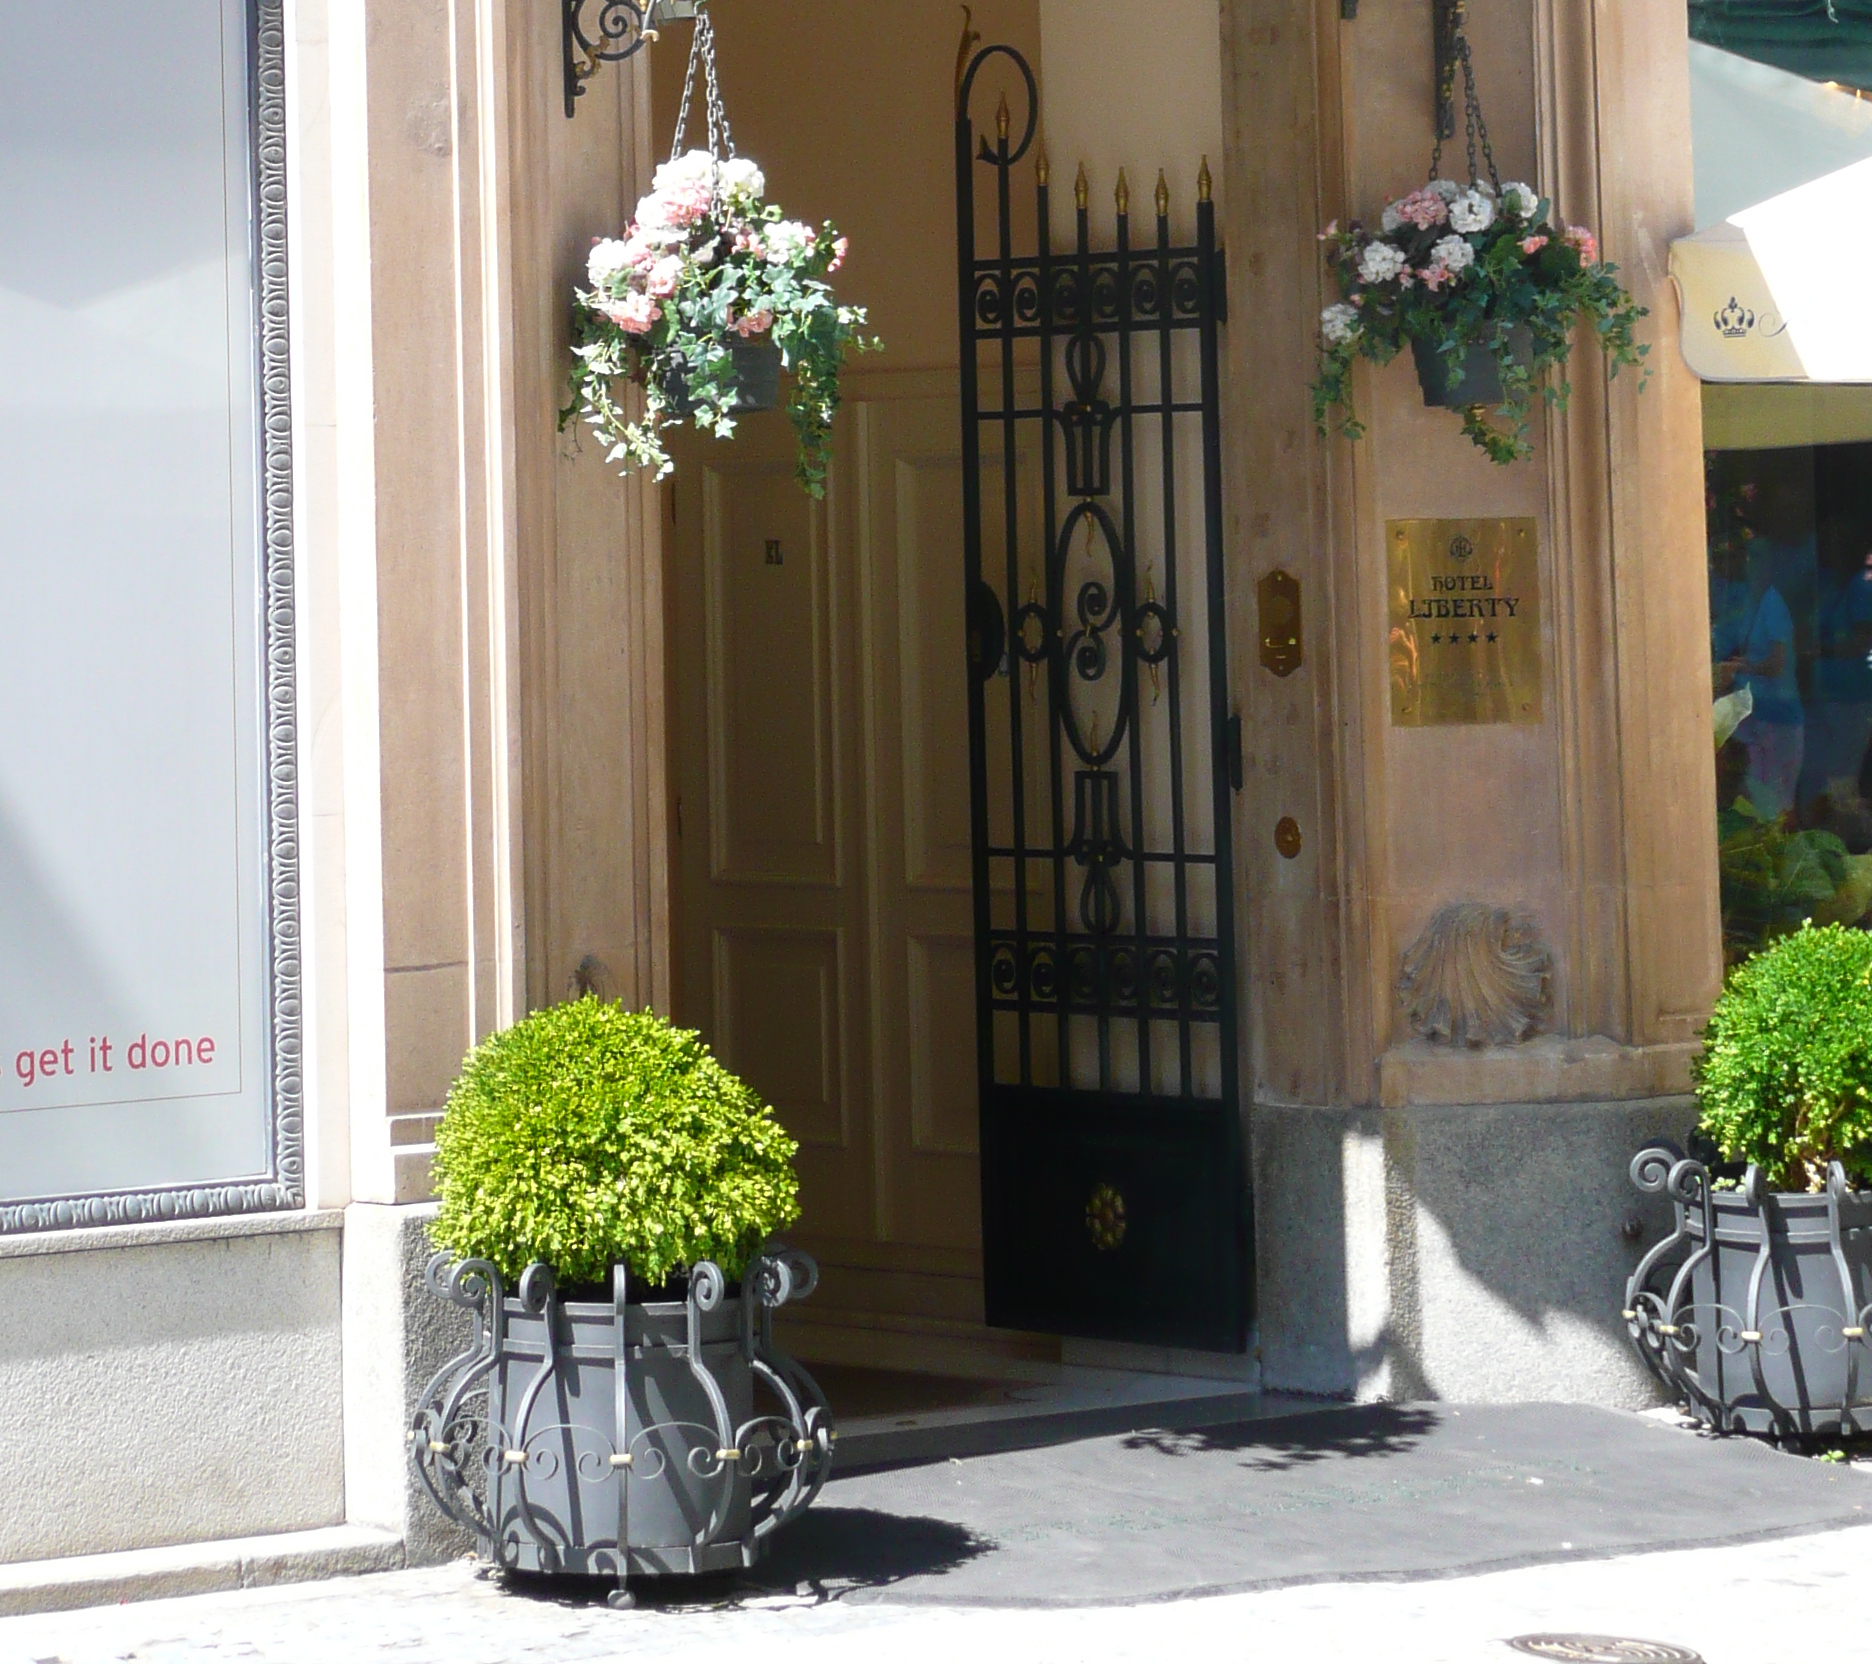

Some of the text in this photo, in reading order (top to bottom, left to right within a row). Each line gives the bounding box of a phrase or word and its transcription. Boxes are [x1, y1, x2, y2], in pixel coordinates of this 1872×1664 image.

[16, 1033, 216, 1087] get it done
